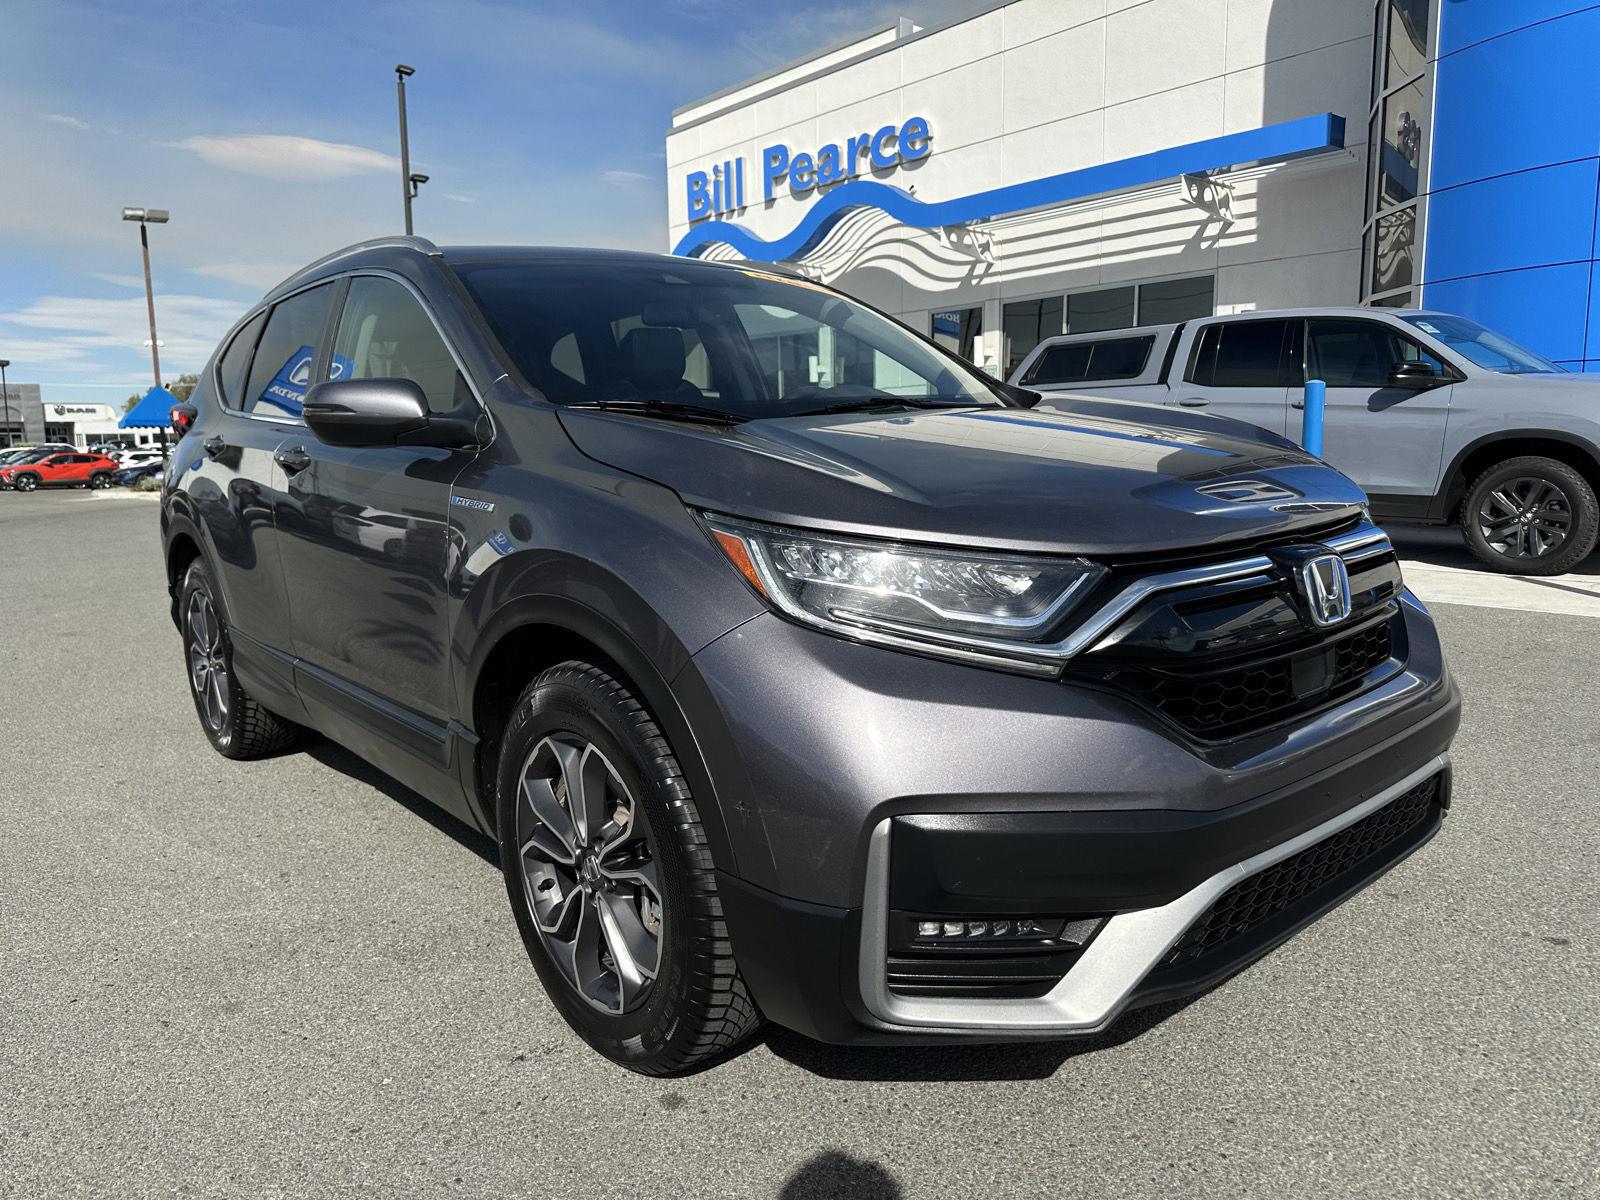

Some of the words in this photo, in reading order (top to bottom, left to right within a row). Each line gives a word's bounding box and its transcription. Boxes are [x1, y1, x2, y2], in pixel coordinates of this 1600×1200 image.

[686, 157, 744, 221] Bill
[763, 116, 930, 200] Pearce
[456, 497, 491, 511] HYBRID
